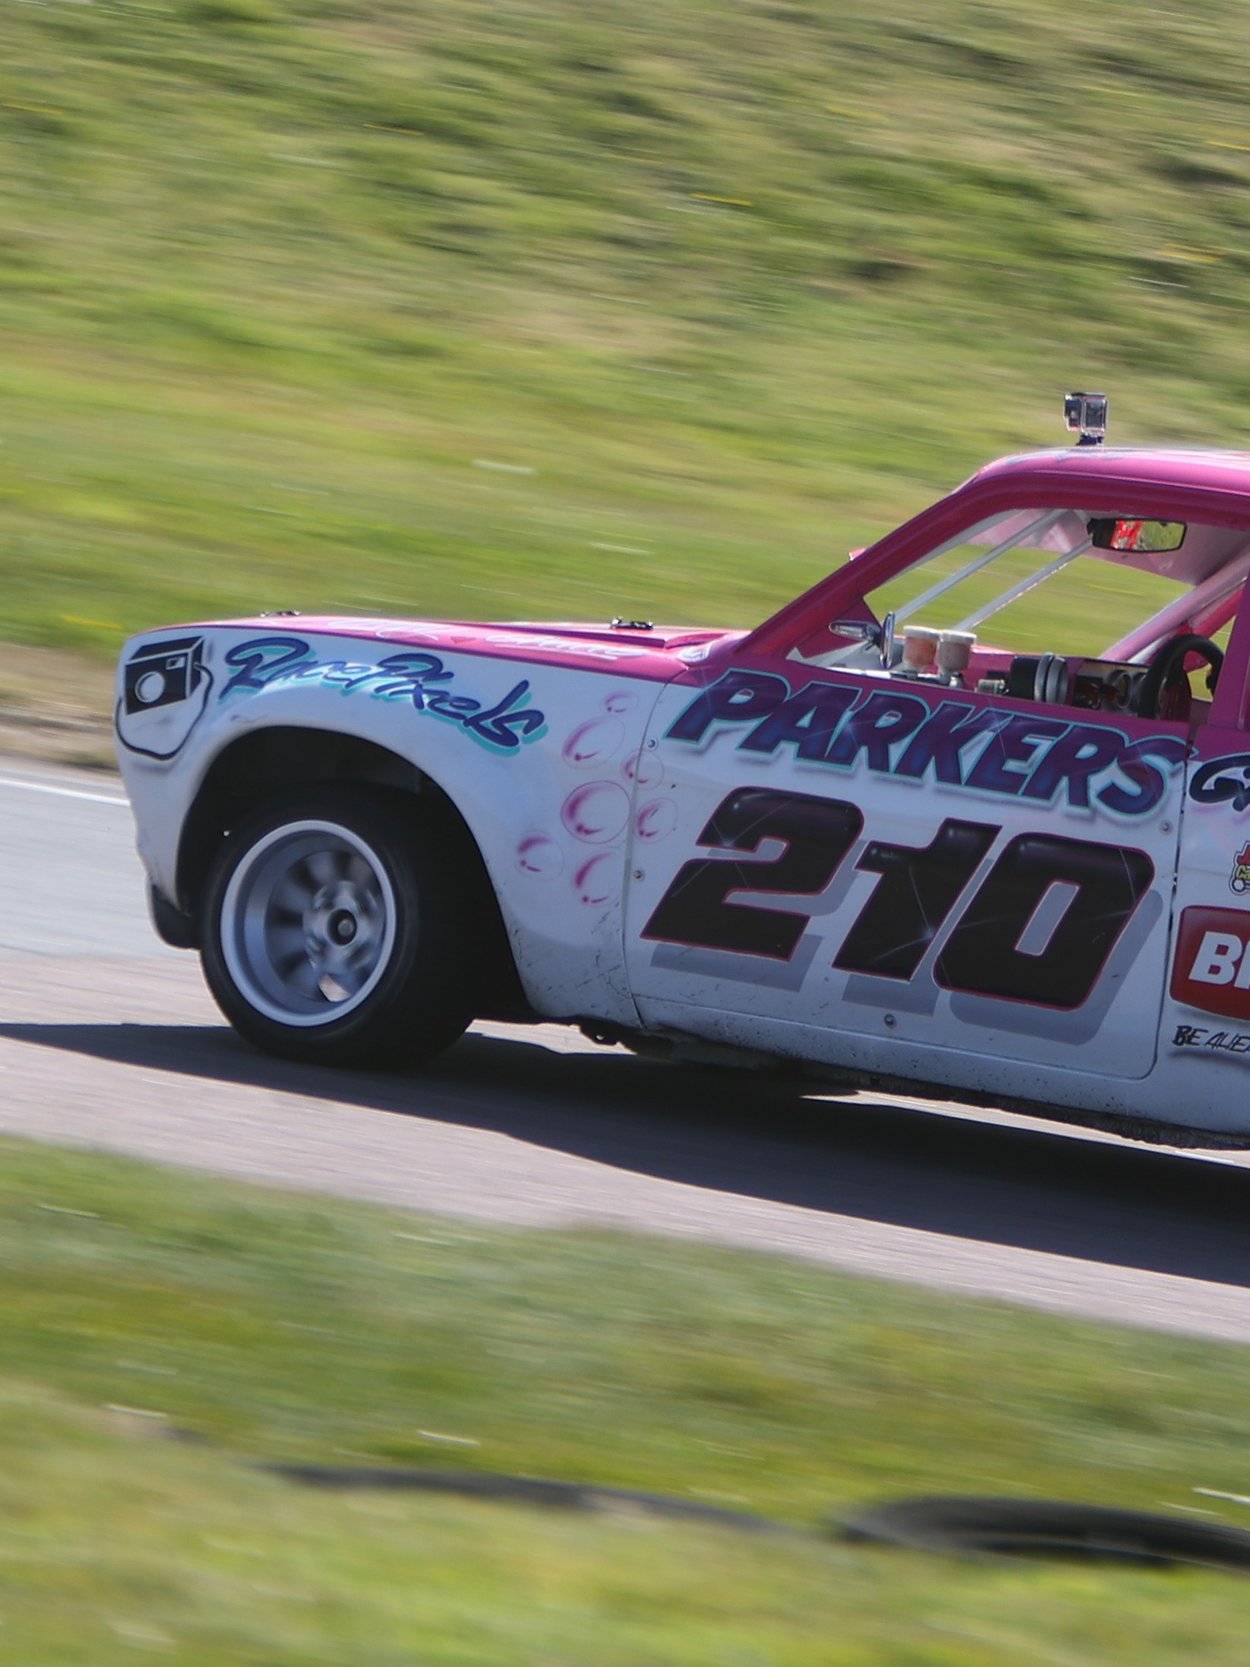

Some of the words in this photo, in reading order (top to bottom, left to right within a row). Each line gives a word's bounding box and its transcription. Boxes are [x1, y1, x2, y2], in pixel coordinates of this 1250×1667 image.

[217, 636, 547, 752] RacePixels
[664, 669, 1198, 815] PARKERS
[640, 785, 1156, 1012] 210
[1171, 1025, 1209, 1047] BE
